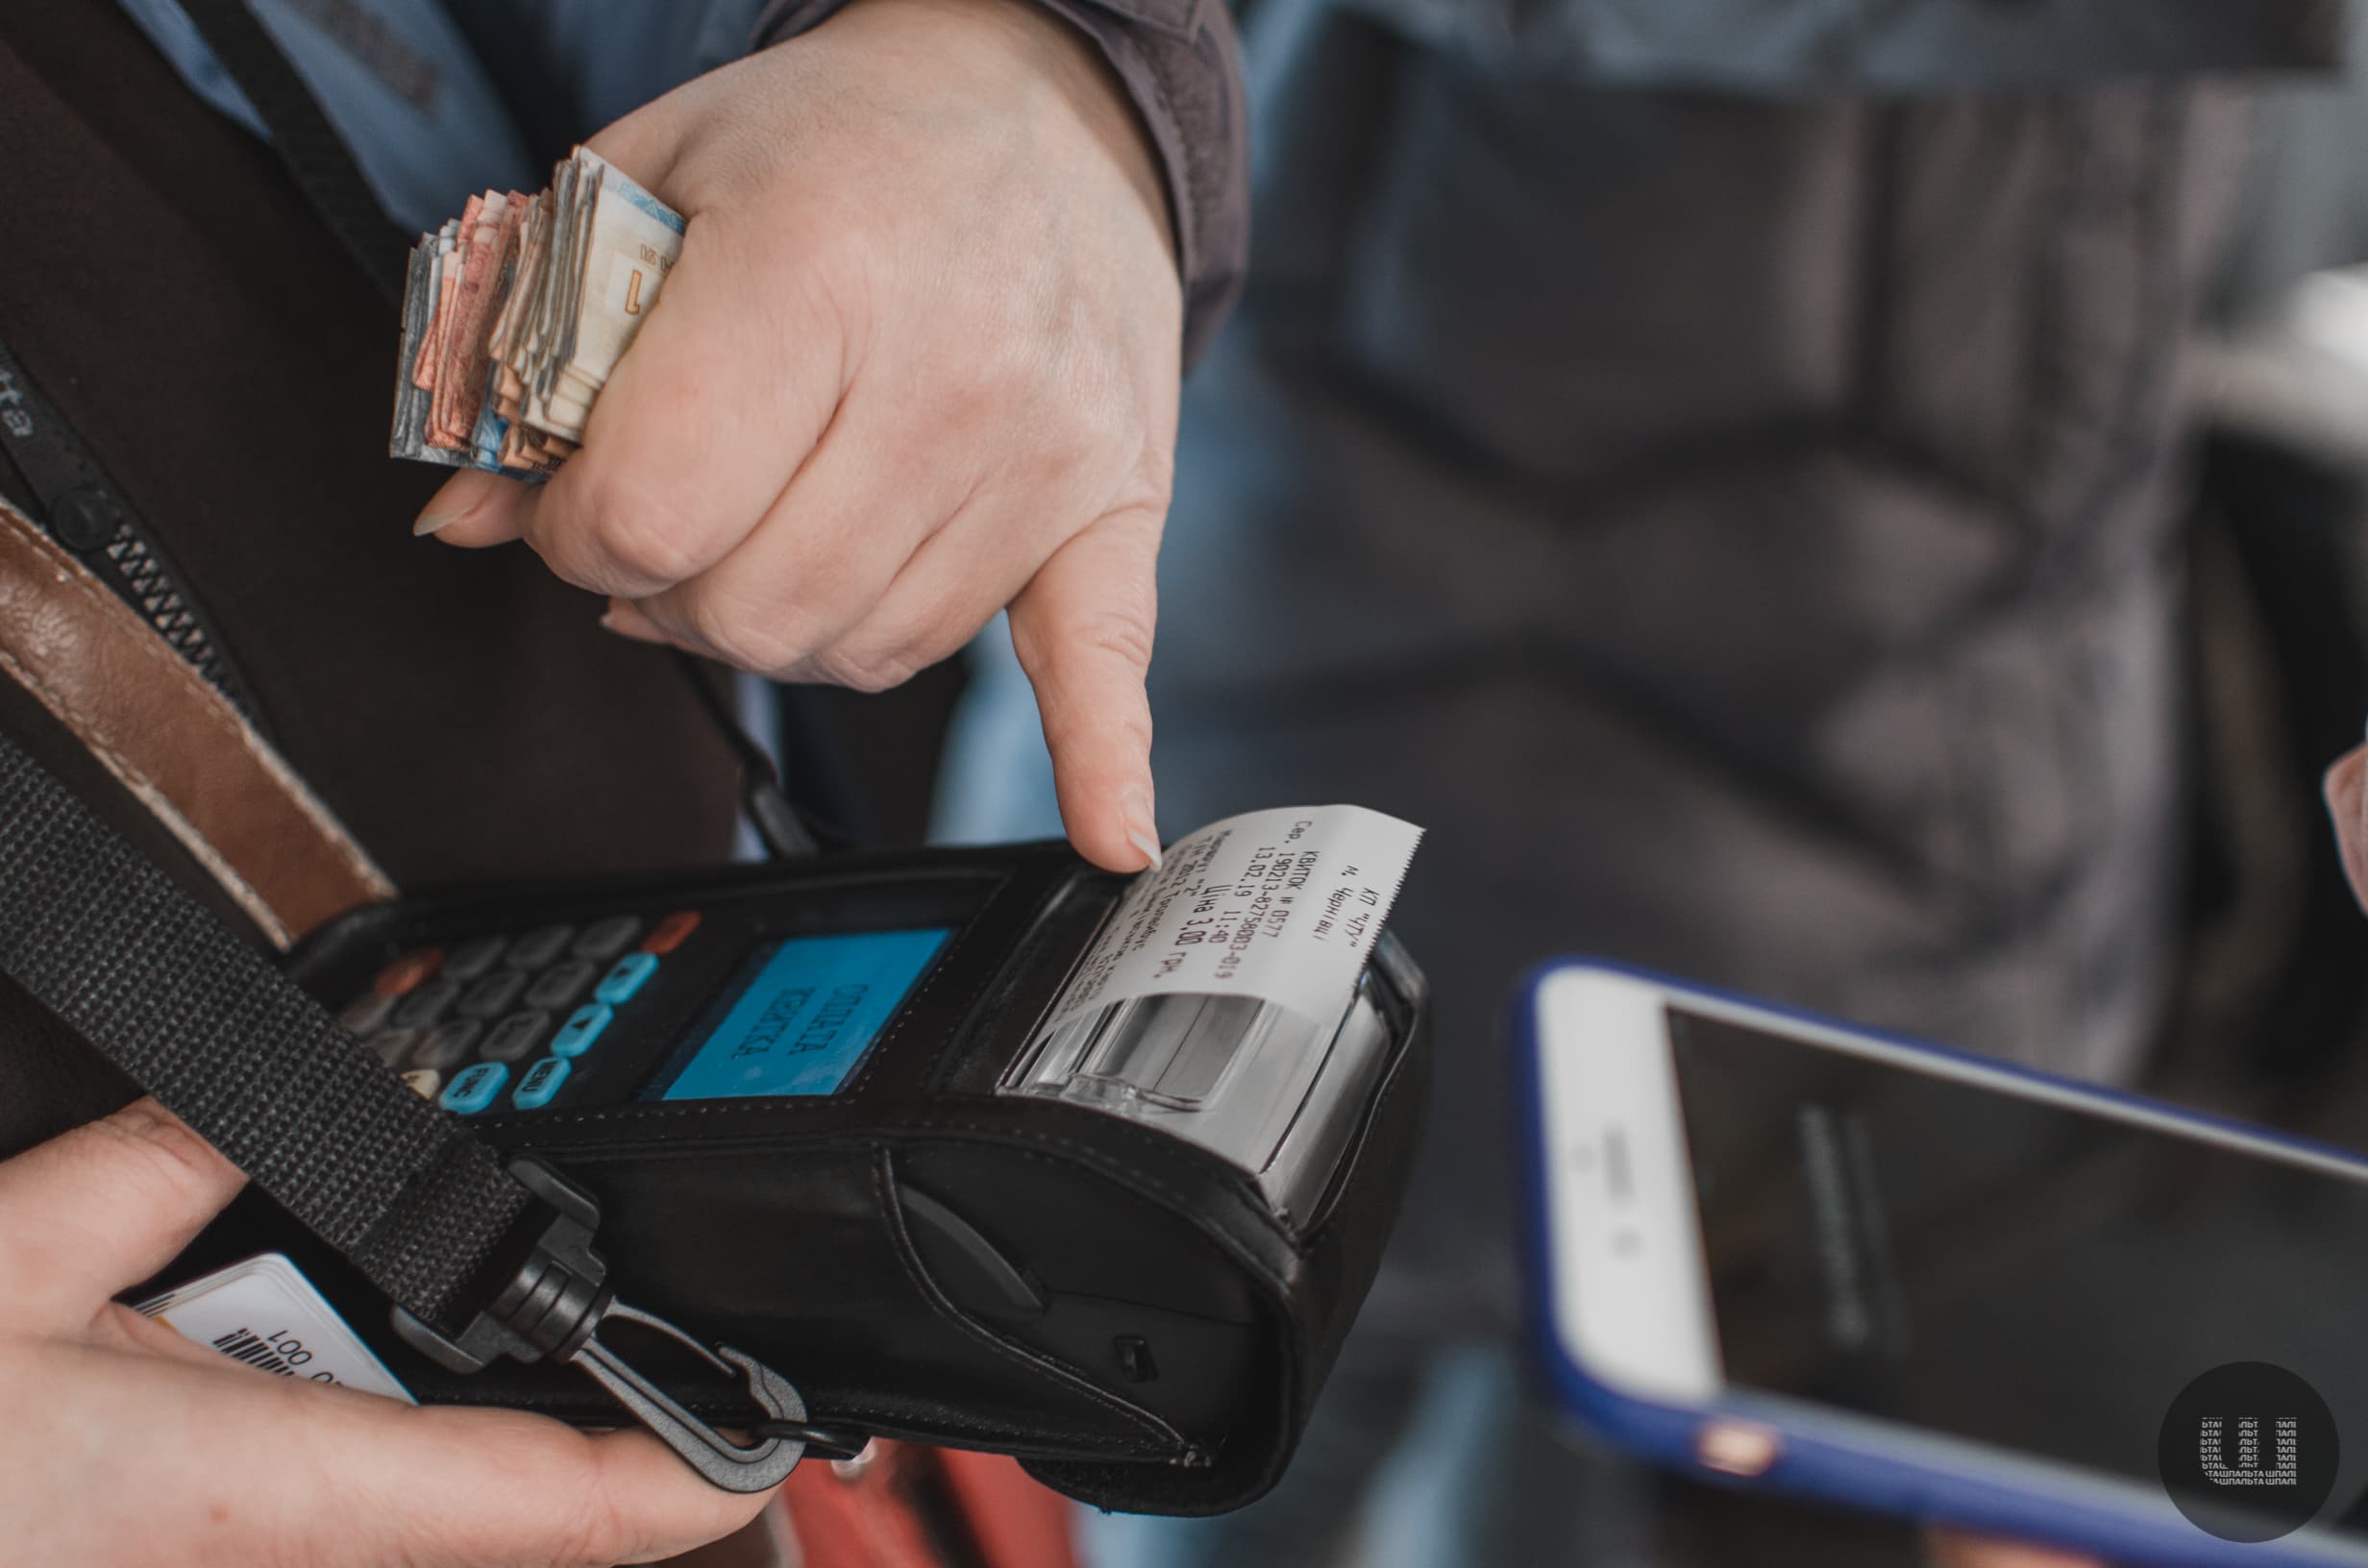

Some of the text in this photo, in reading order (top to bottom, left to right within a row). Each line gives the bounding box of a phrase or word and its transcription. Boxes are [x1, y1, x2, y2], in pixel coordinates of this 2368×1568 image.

[624, 269, 644, 316] 1
[1285, 850, 1320, 890] КВИТОК
[1193, 884, 1233, 913] Ціна
[1208, 846, 1276, 943] 13.02.19 11:40
[1359, 887, 1380, 906] КП
[1261, 909, 1290, 938] 0577
[1313, 887, 1354, 942] Чернівці
[1174, 918, 1214, 946] 3.00
